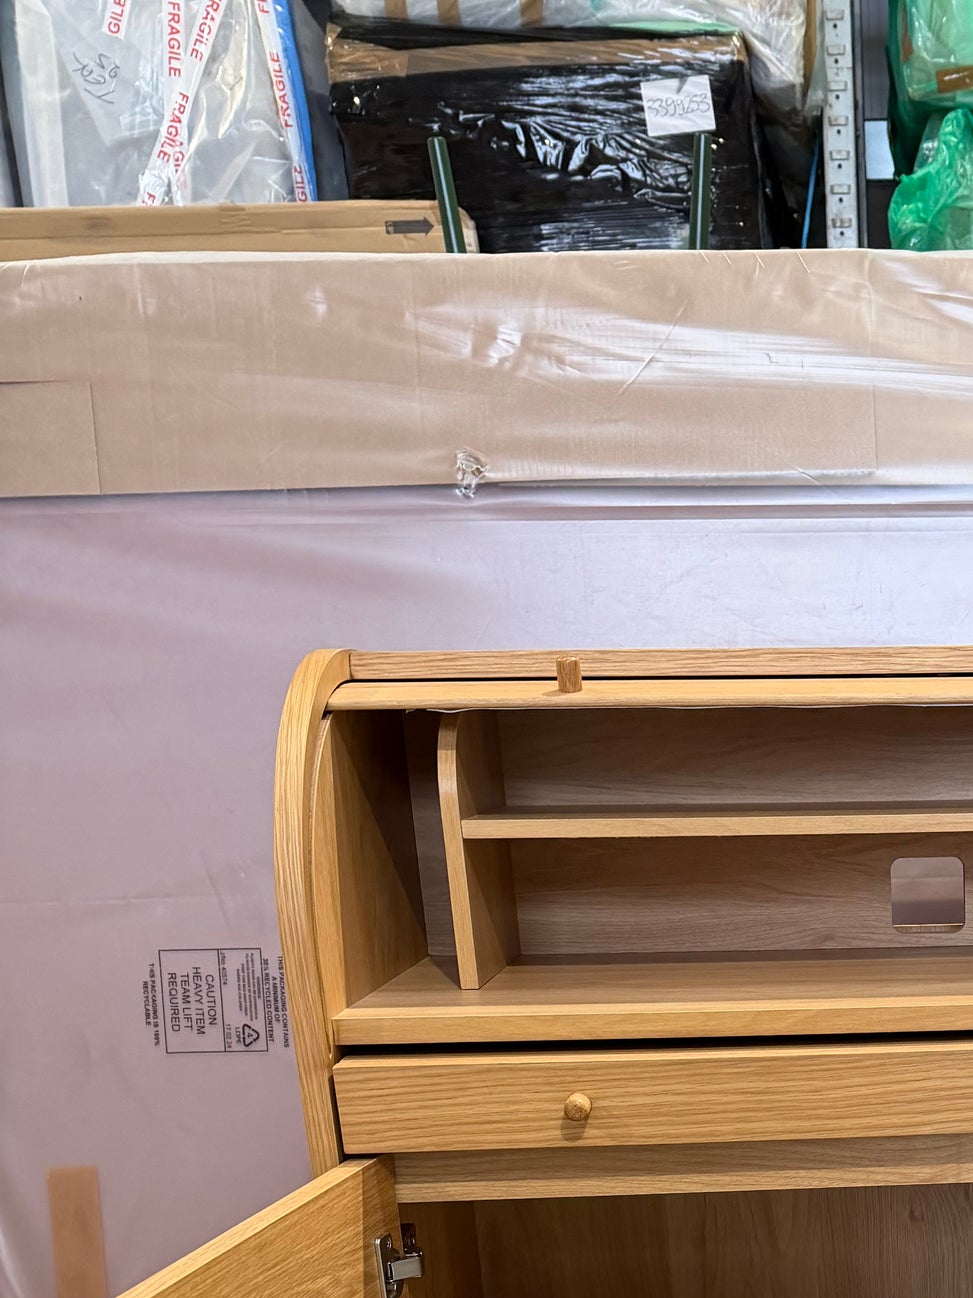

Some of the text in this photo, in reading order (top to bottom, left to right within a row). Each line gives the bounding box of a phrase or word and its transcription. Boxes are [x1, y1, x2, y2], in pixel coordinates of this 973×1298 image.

[168, 1, 182, 78] FRAGILE
[190, 0, 222, 62] RAGILE
[269, 50, 294, 129] FRAGILE
[157, 91, 190, 163] FRAGILE
[143, 981, 151, 1026] RECYCLABLE
[168, 972, 180, 1032] REQUIRED
[180, 972, 193, 1031] TEAM LIFT
[192, 967, 205, 1034] HEAVY ITEM
[205, 974, 217, 1026] CAUTION
[264, 973, 272, 1009] RECYCLED
[279, 972, 287, 1012] PACKAGING
